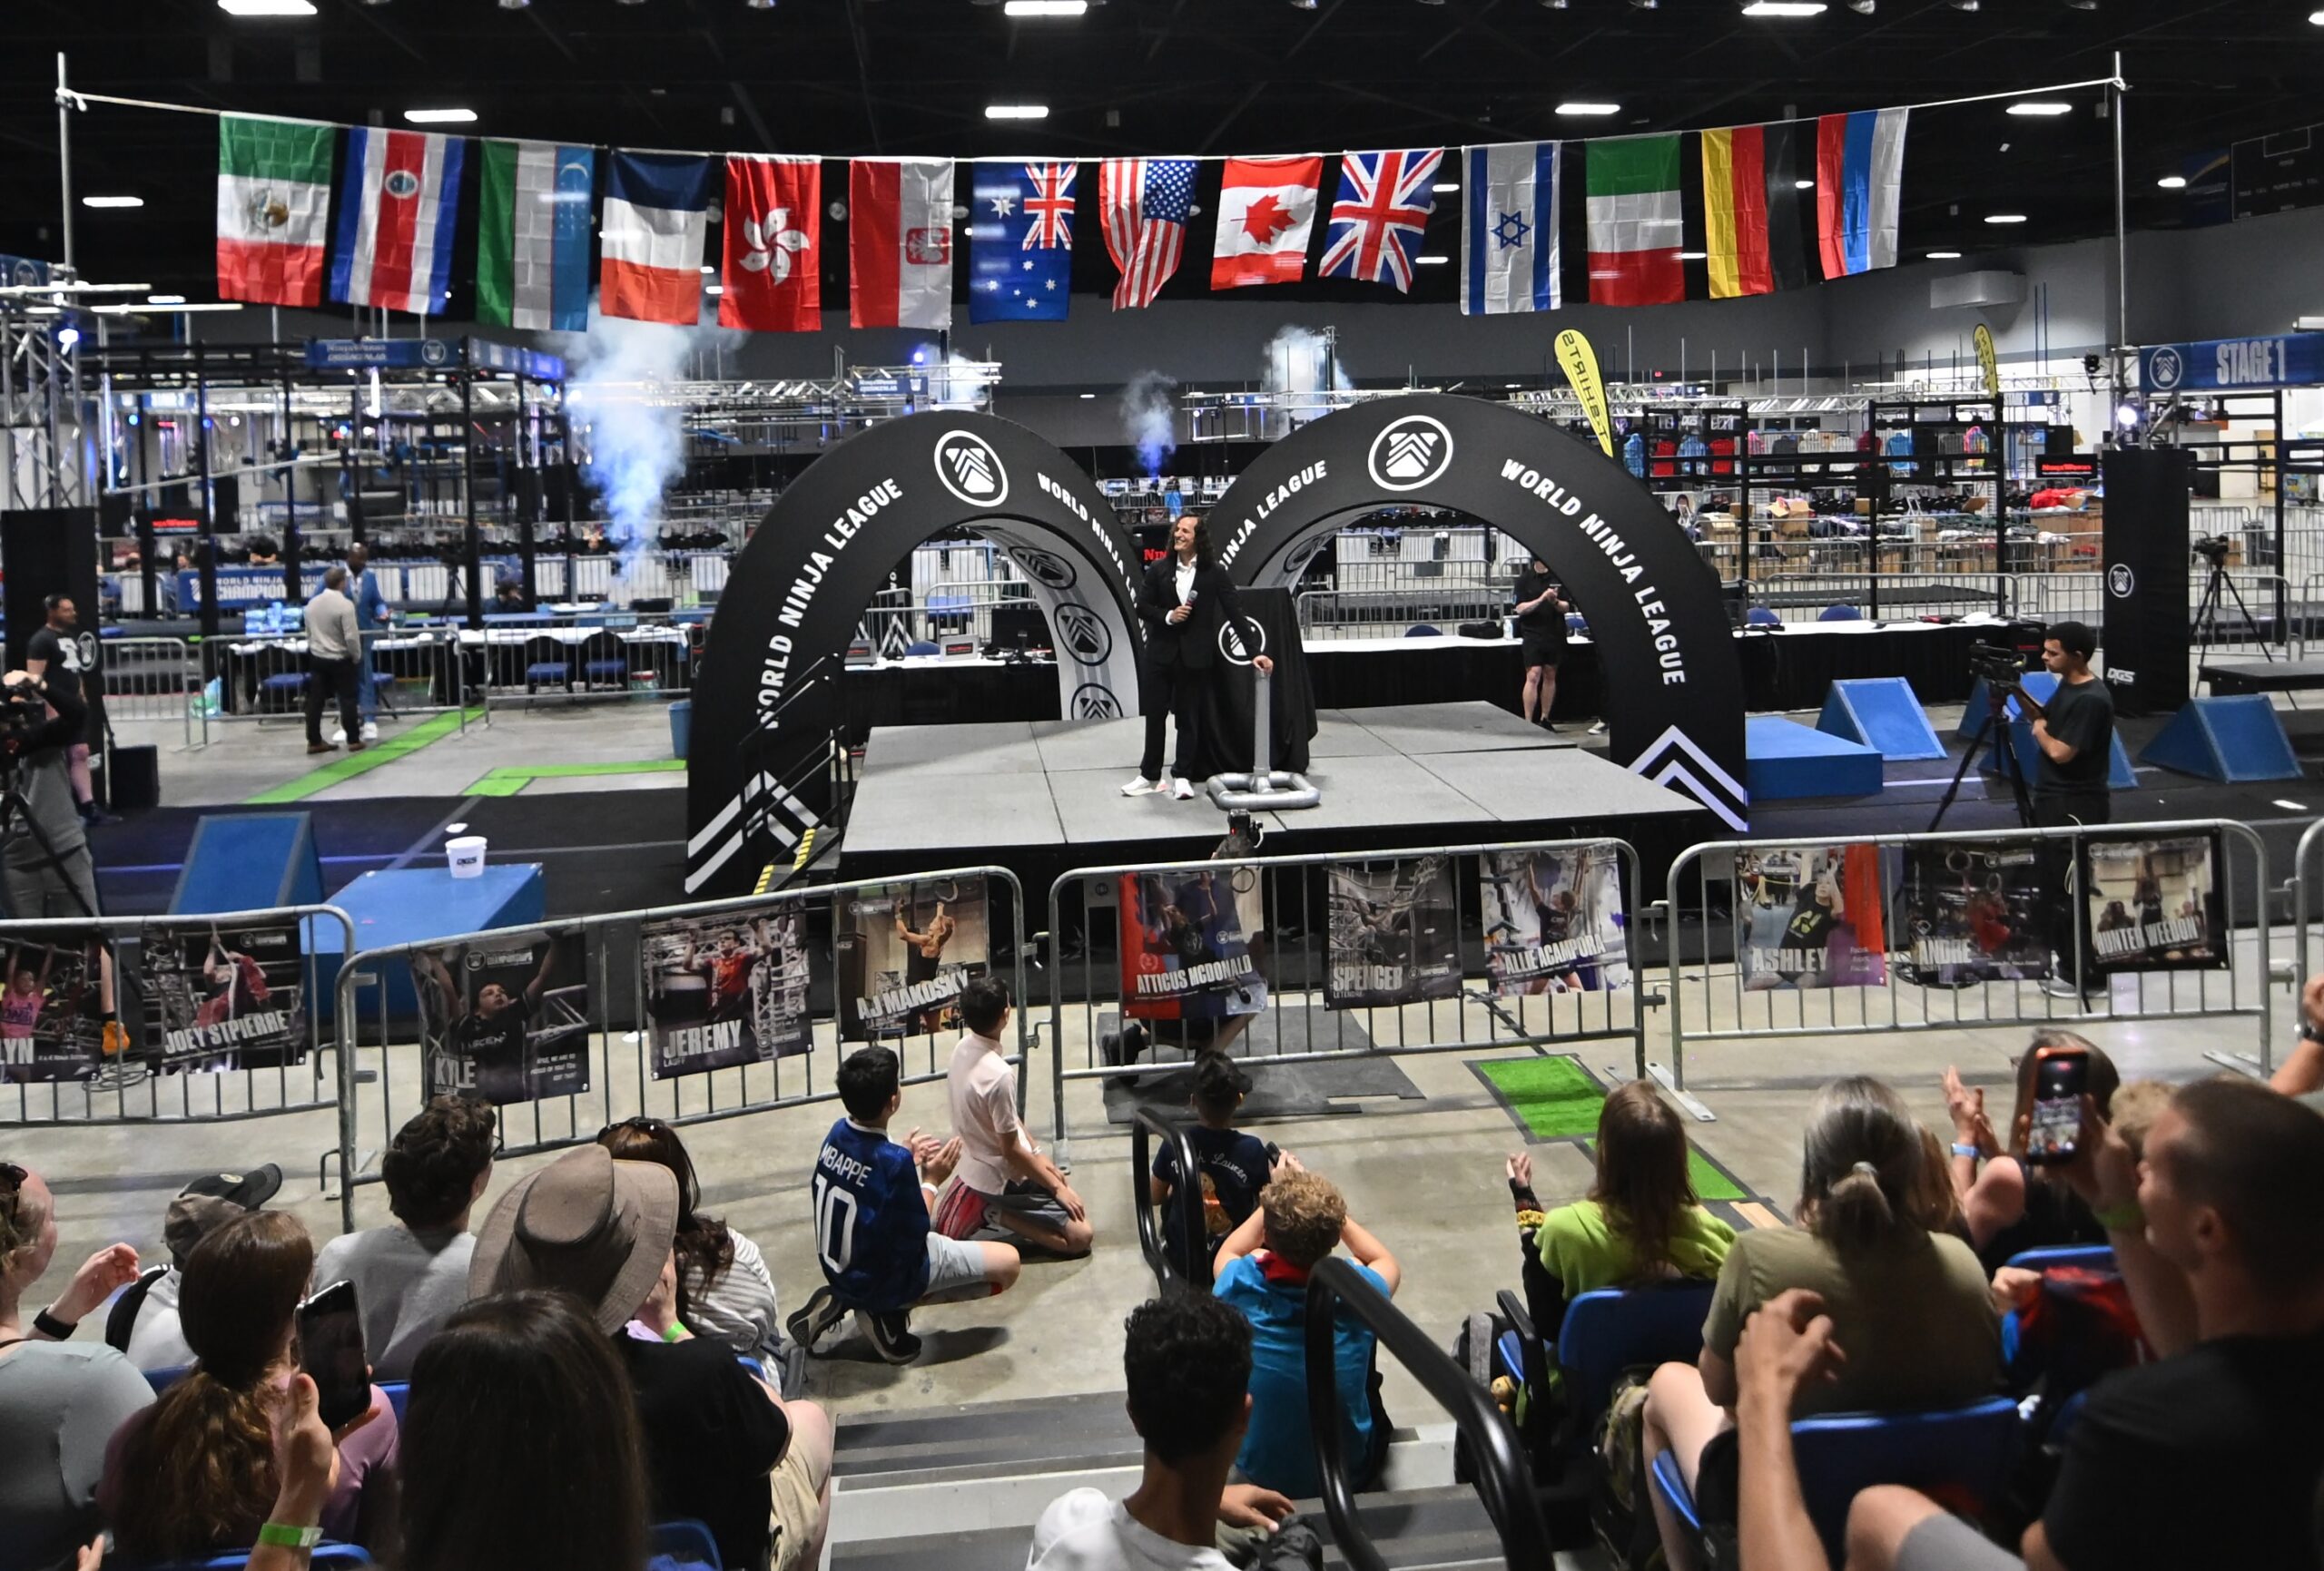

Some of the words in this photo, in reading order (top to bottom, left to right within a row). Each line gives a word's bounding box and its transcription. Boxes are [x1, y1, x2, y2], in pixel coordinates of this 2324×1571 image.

[2216, 339, 2273, 385] STAGE
[2276, 339, 2286, 382] 1
[1256, 459, 1327, 519] LEAGUE
[1037, 472, 1088, 522] WORLD
[1091, 517, 1124, 576] NINJA
[216, 576, 250, 585] WORLD
[252, 575, 284, 584] NINJA
[1501, 458, 1581, 516] WORLD
[1579, 513, 1644, 584] NINJA
[1634, 585, 1686, 685] LEAGUE
[756, 634, 793, 730] WORLD
[778, 551, 834, 628] NINJA
[823, 477, 903, 550] LEAGUE
[1504, 950, 1539, 975] ALLIE
[1538, 934, 1606, 968] ACAMPORA
[2095, 927, 2146, 956] HUNTER
[2144, 916, 2199, 948] WEEDON
[1137, 969, 1188, 994] ATTICUS
[1188, 955, 1253, 987] MCDONALD
[1333, 965, 1403, 992] SPENCER
[1751, 947, 1828, 972] ASHLEY
[882, 969, 969, 1015] MAKOSKY
[0, 1037, 34, 1065] YN
[164, 1026, 206, 1055] JOEY
[663, 1019, 742, 1059] JEREMY
[435, 1056, 477, 1088] KYLE
[819, 1142, 872, 1187] MBAPPE
[815, 1173, 858, 1273] 10
